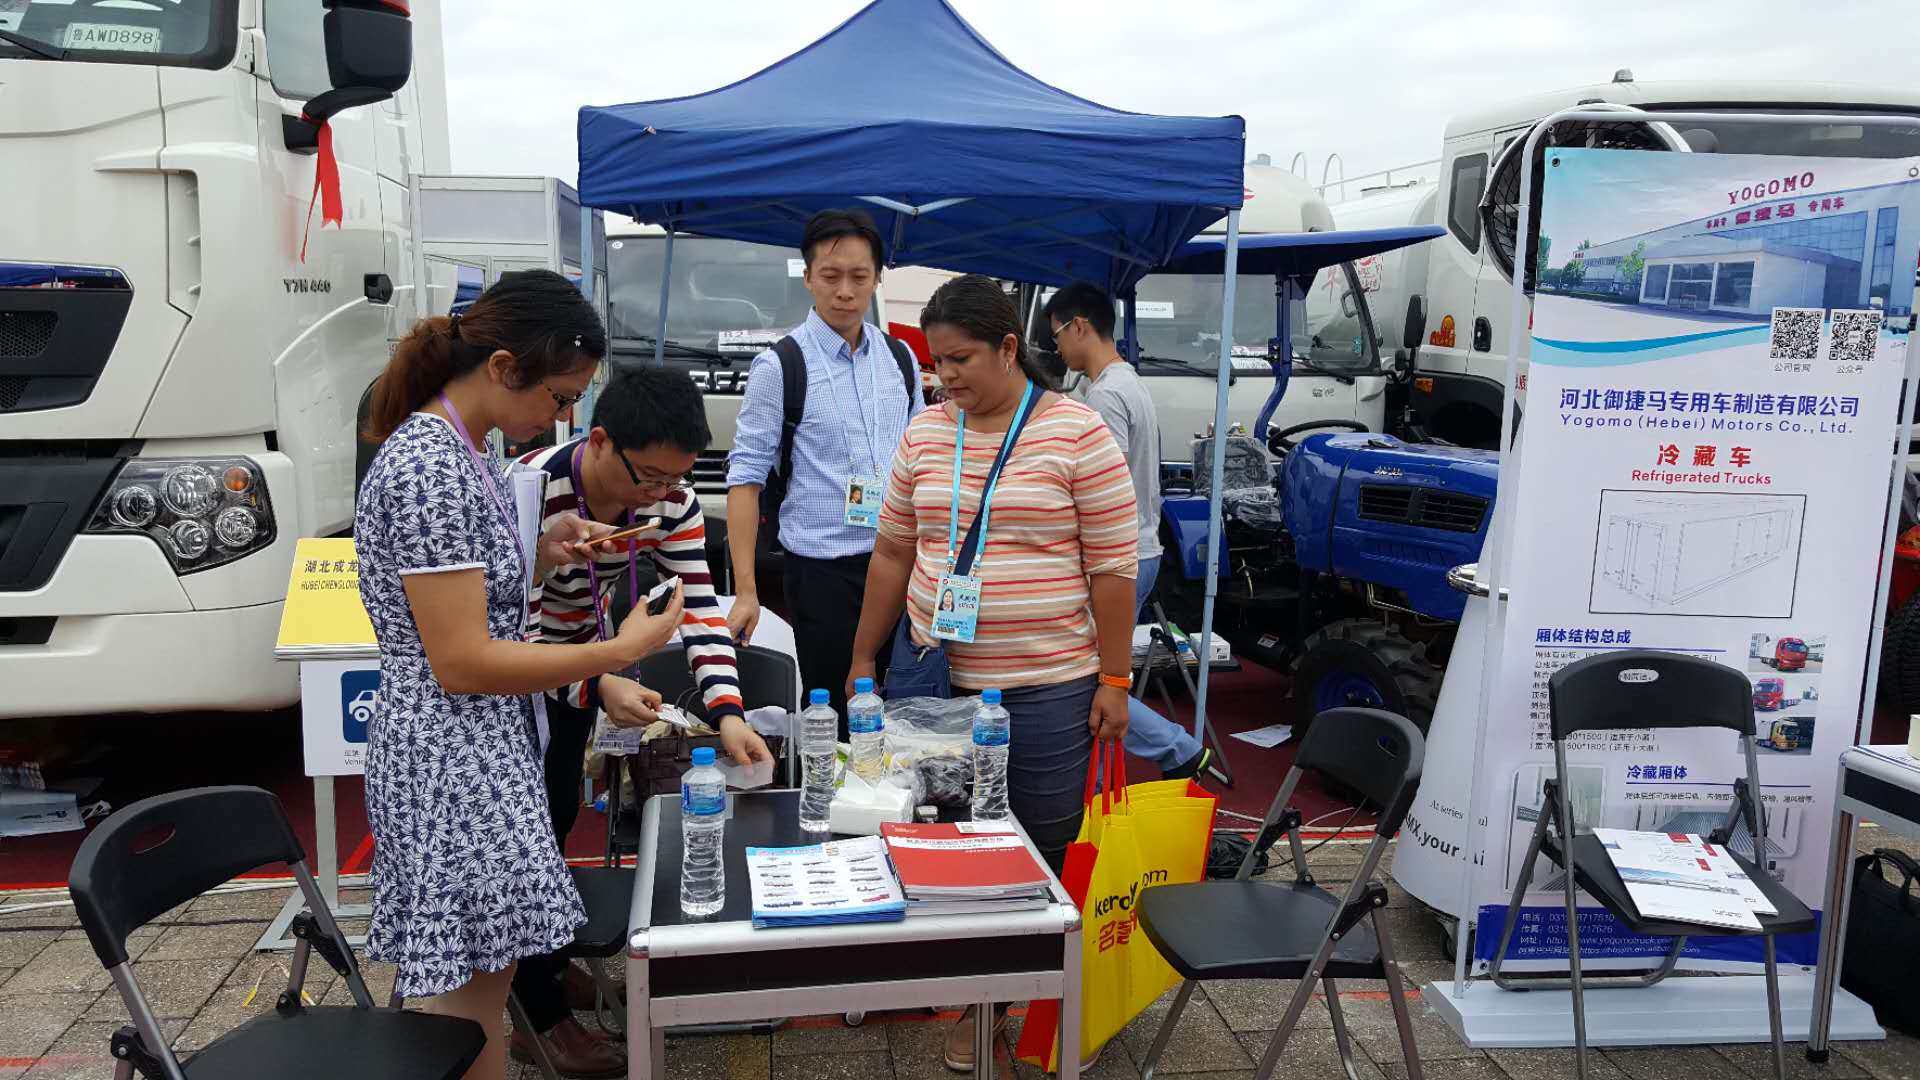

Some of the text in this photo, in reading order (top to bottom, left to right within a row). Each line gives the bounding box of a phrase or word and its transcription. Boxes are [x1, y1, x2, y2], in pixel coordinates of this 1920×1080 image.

[1727, 171, 1815, 205] YOGOMO
[1559, 388, 1859, 417] 河北御捷马专用车制造有限公司
[1559, 414, 1632, 429] Yogomo
[1711, 418, 1774, 432] Motors
[1778, 420, 1815, 435] Co.,
[1819, 420, 1853, 434] Ltd.
[1656, 444, 1752, 467] 冷藏车
[1632, 469, 1772, 485] Refrigerated Trucks
[304, 559, 360, 574] 湖北成龙
[1535, 628, 1632, 645] 厢体结构总成
[1626, 764, 1688, 781] 冷藏厢体
